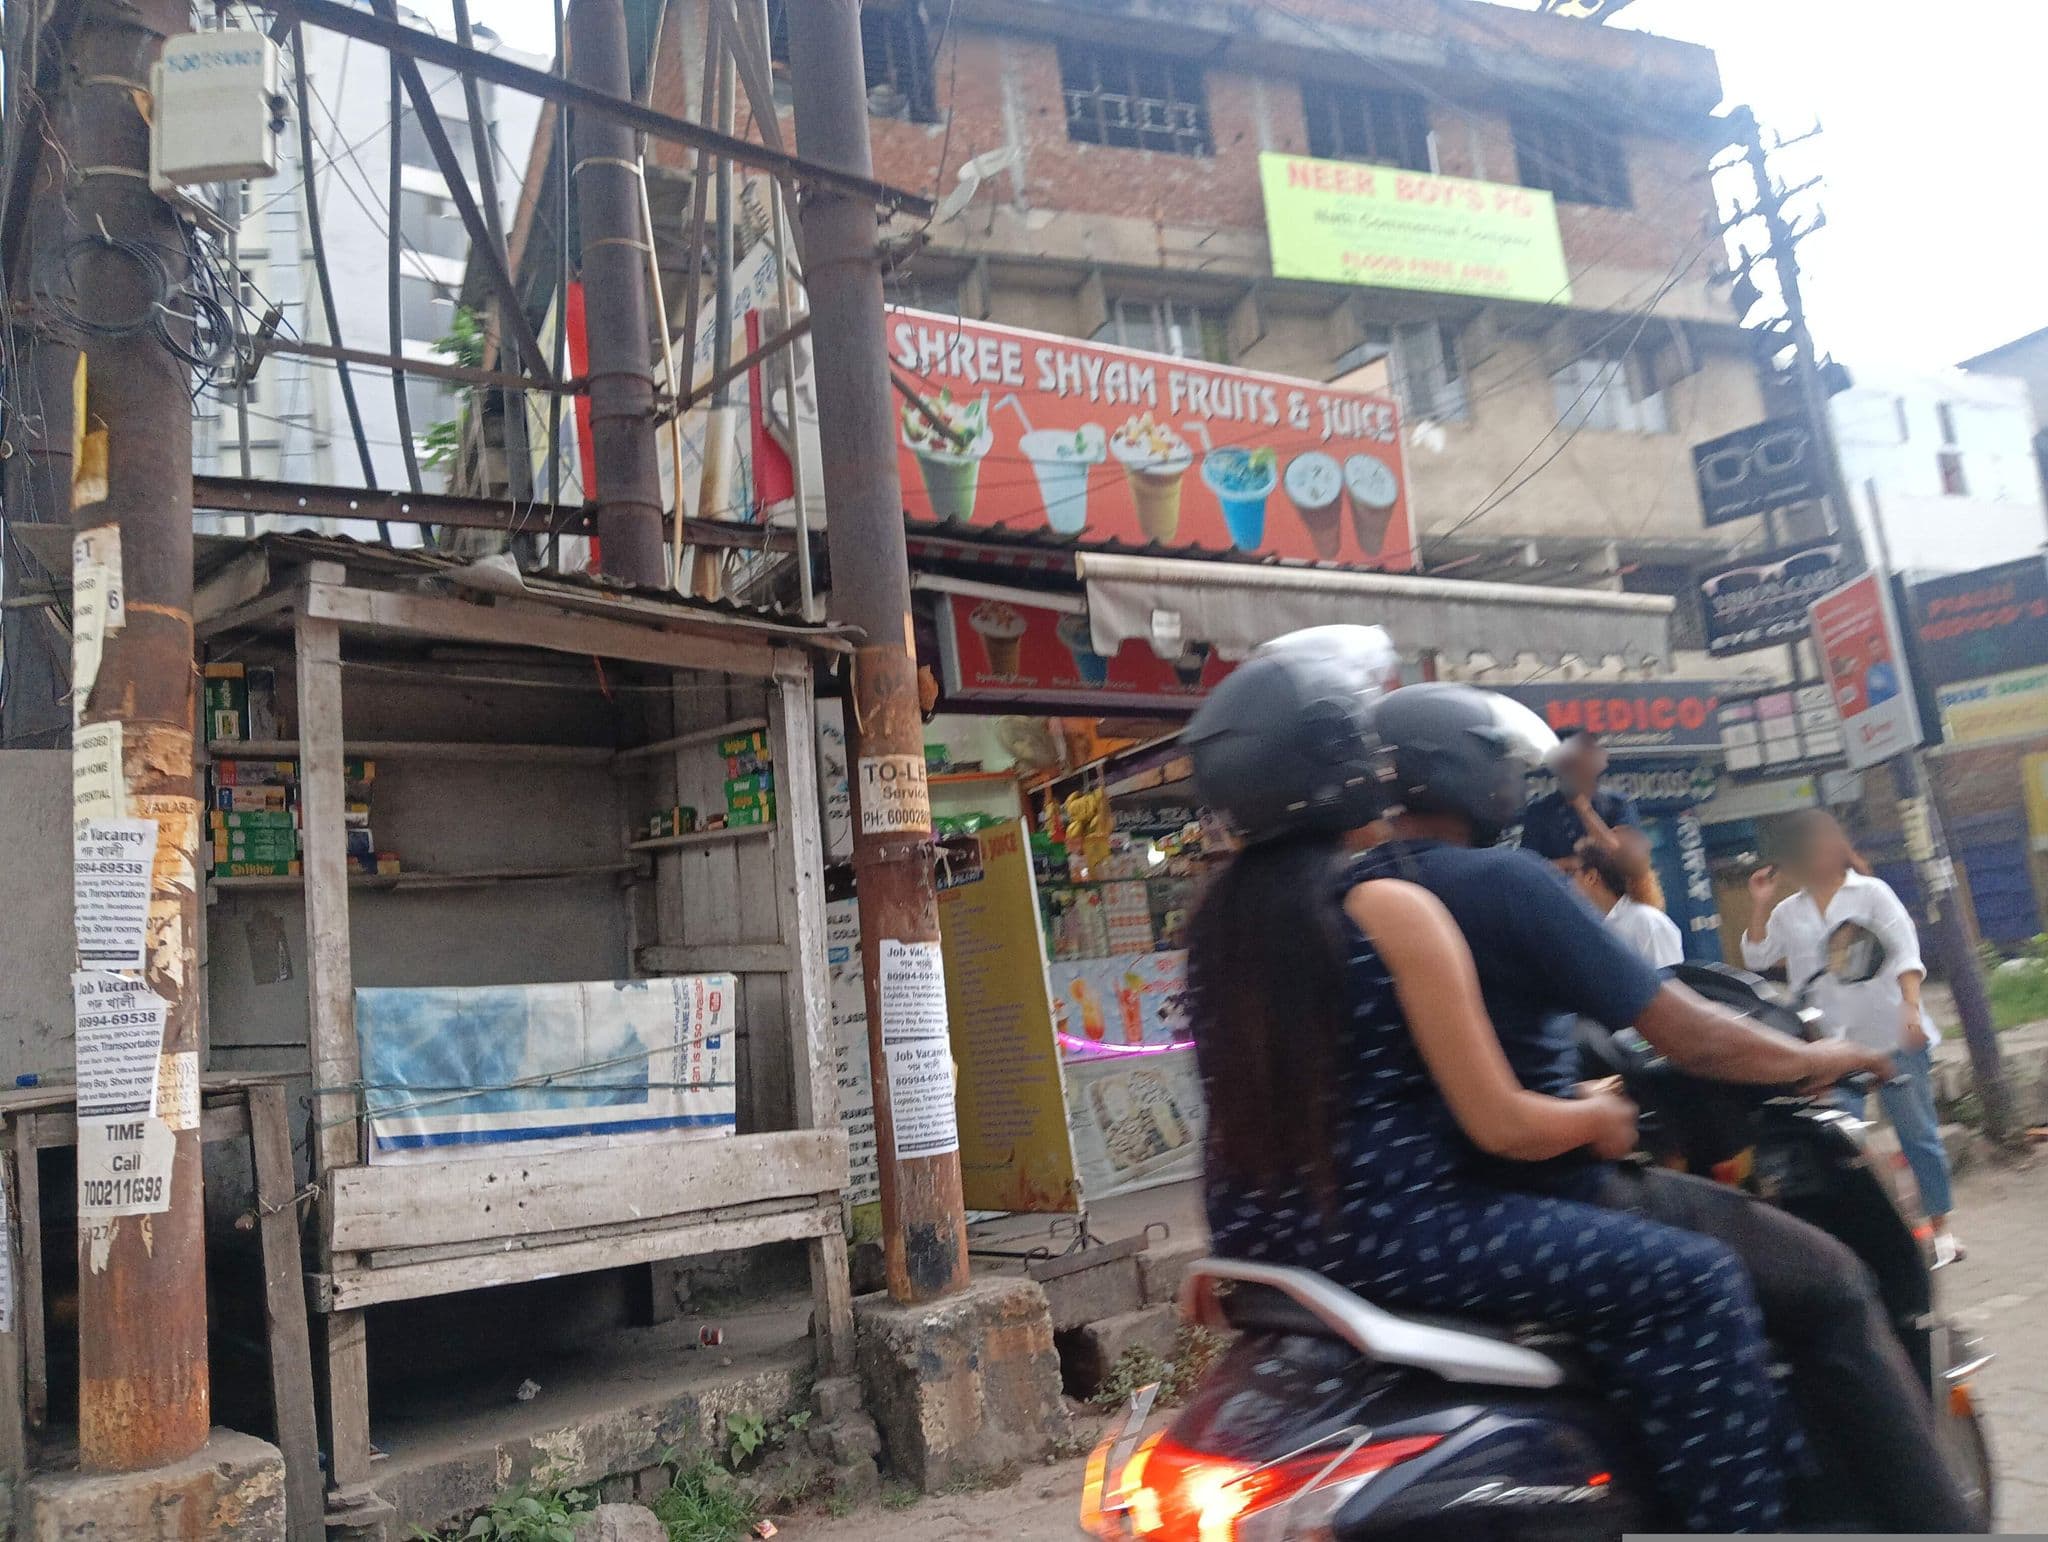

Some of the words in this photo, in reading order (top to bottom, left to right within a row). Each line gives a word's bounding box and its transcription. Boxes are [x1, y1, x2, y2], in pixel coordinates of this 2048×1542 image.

[1287, 161, 1376, 197] NEER
[1494, 189, 1533, 218] PG
[894, 322, 1025, 387] SHREE
[1035, 348, 1159, 408] SHYAM
[1169, 369, 1280, 427] FRUITS
[1288, 392, 1312, 433] &
[1319, 395, 1396, 444] JUICE
[90, 828, 146, 846] Vacancy
[887, 947, 906, 957] Job
[682, 1010, 690, 1033] NAME
[101, 1040, 160, 1051] Transportation
[691, 1052, 701, 1063] is
[895, 1050, 913, 1062] Job
[110, 1077, 132, 1086] Show
[105, 1123, 144, 1141] TIME
[112, 1155, 141, 1172] Call
